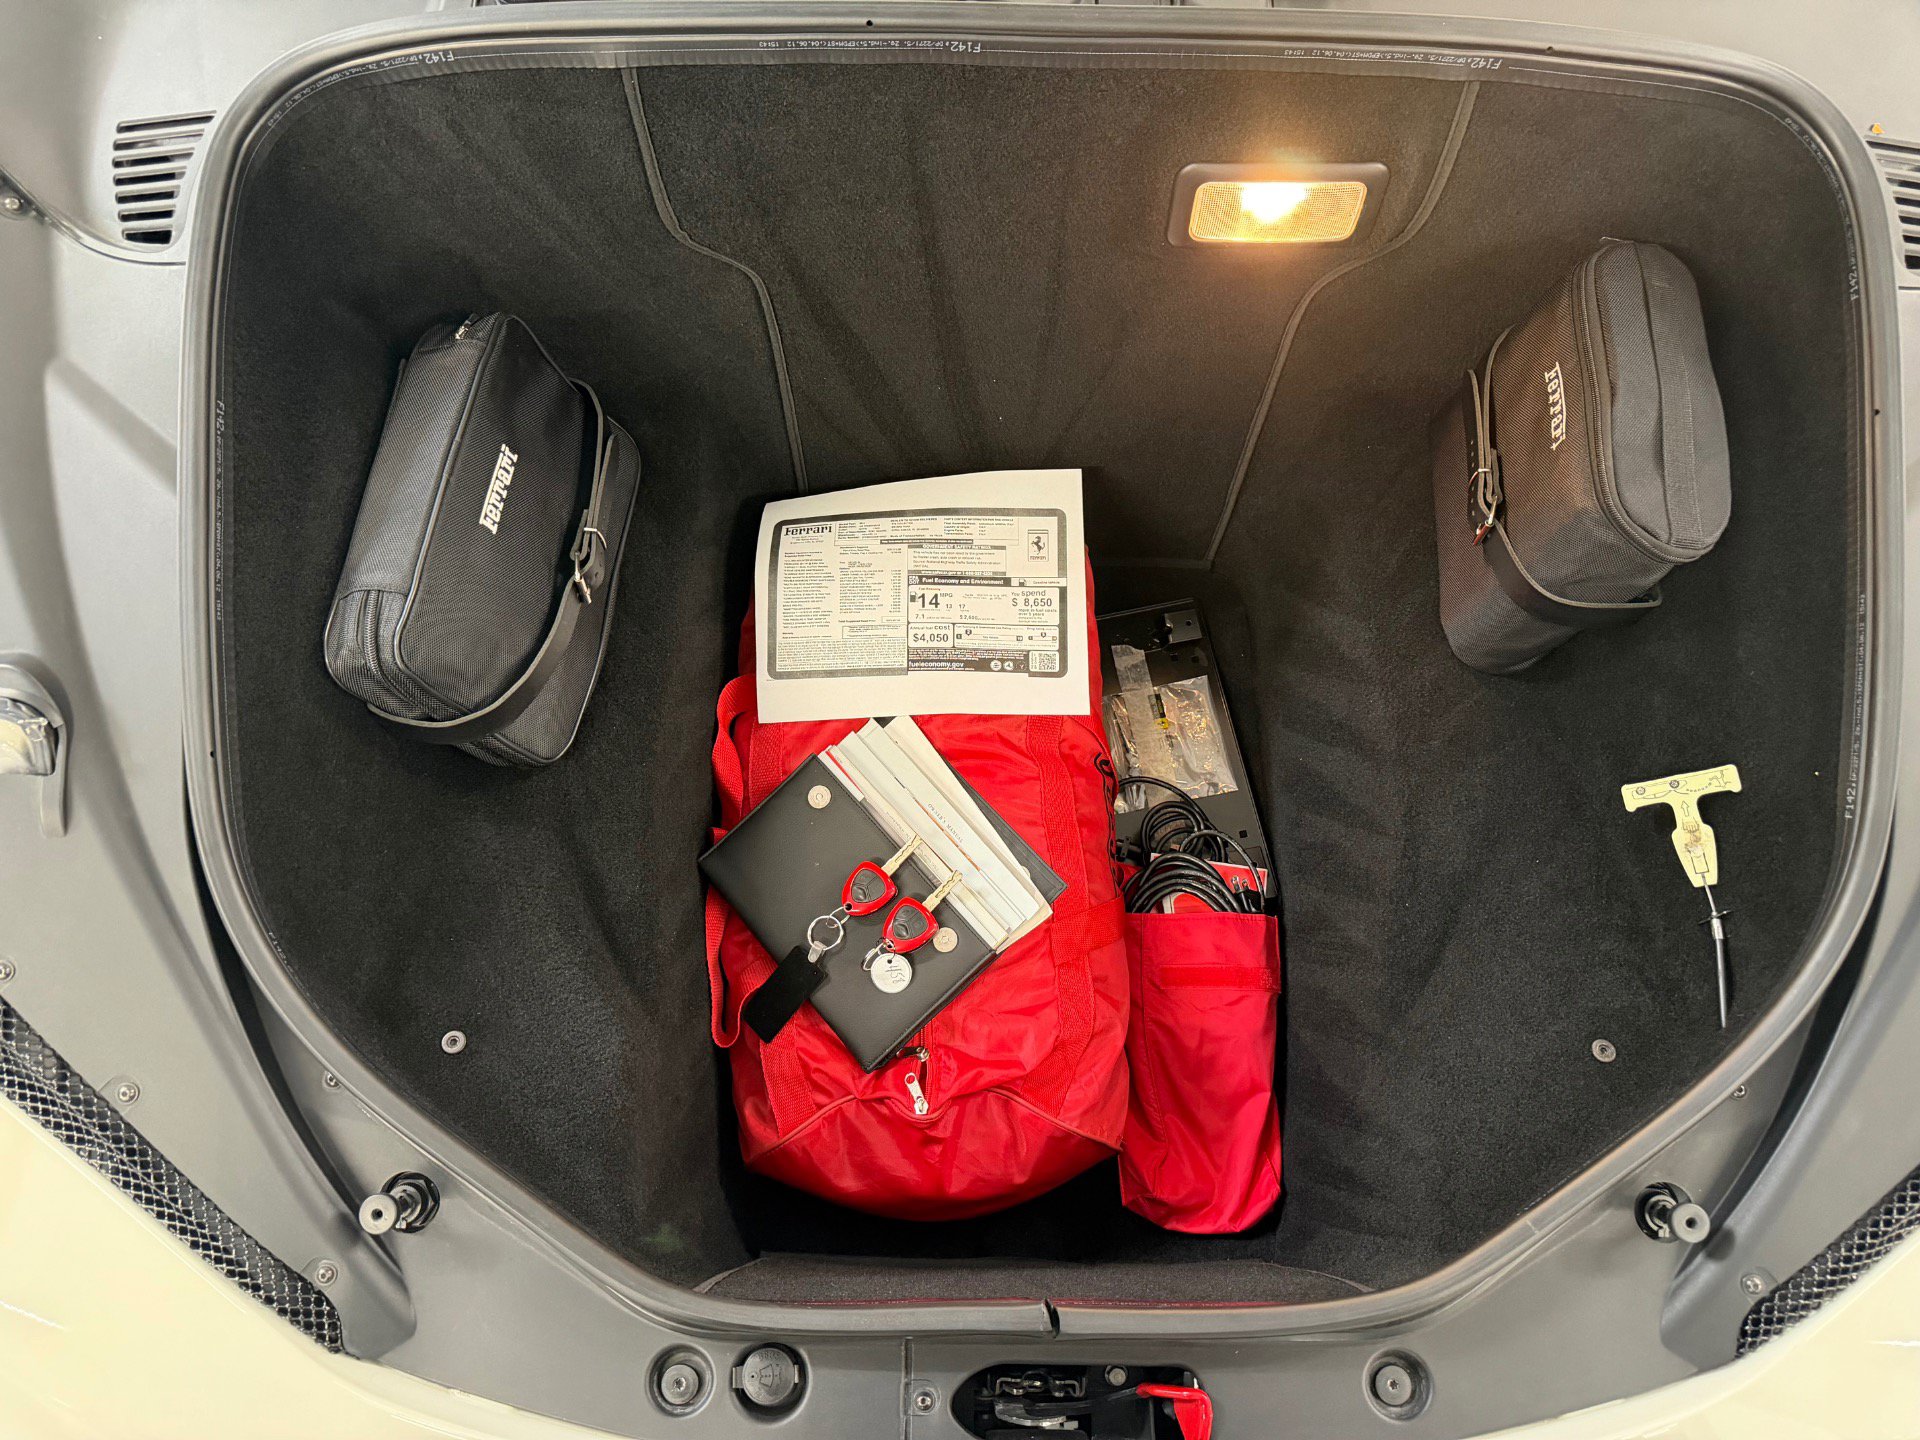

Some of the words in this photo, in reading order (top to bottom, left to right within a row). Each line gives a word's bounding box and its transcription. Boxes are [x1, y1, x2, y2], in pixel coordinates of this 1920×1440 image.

[945, 41, 981, 53] F142,
[418, 50, 455, 64] F142,
[1467, 57, 1503, 70] F142,
[1544, 361, 1567, 451] Ferrari
[479, 443, 518, 535] Ferrari
[784, 524, 832, 536] Ferrari
[918, 593, 940, 608] 14
[1024, 598, 1052, 608] 8,650
[913, 633, 949, 643] $4,050
